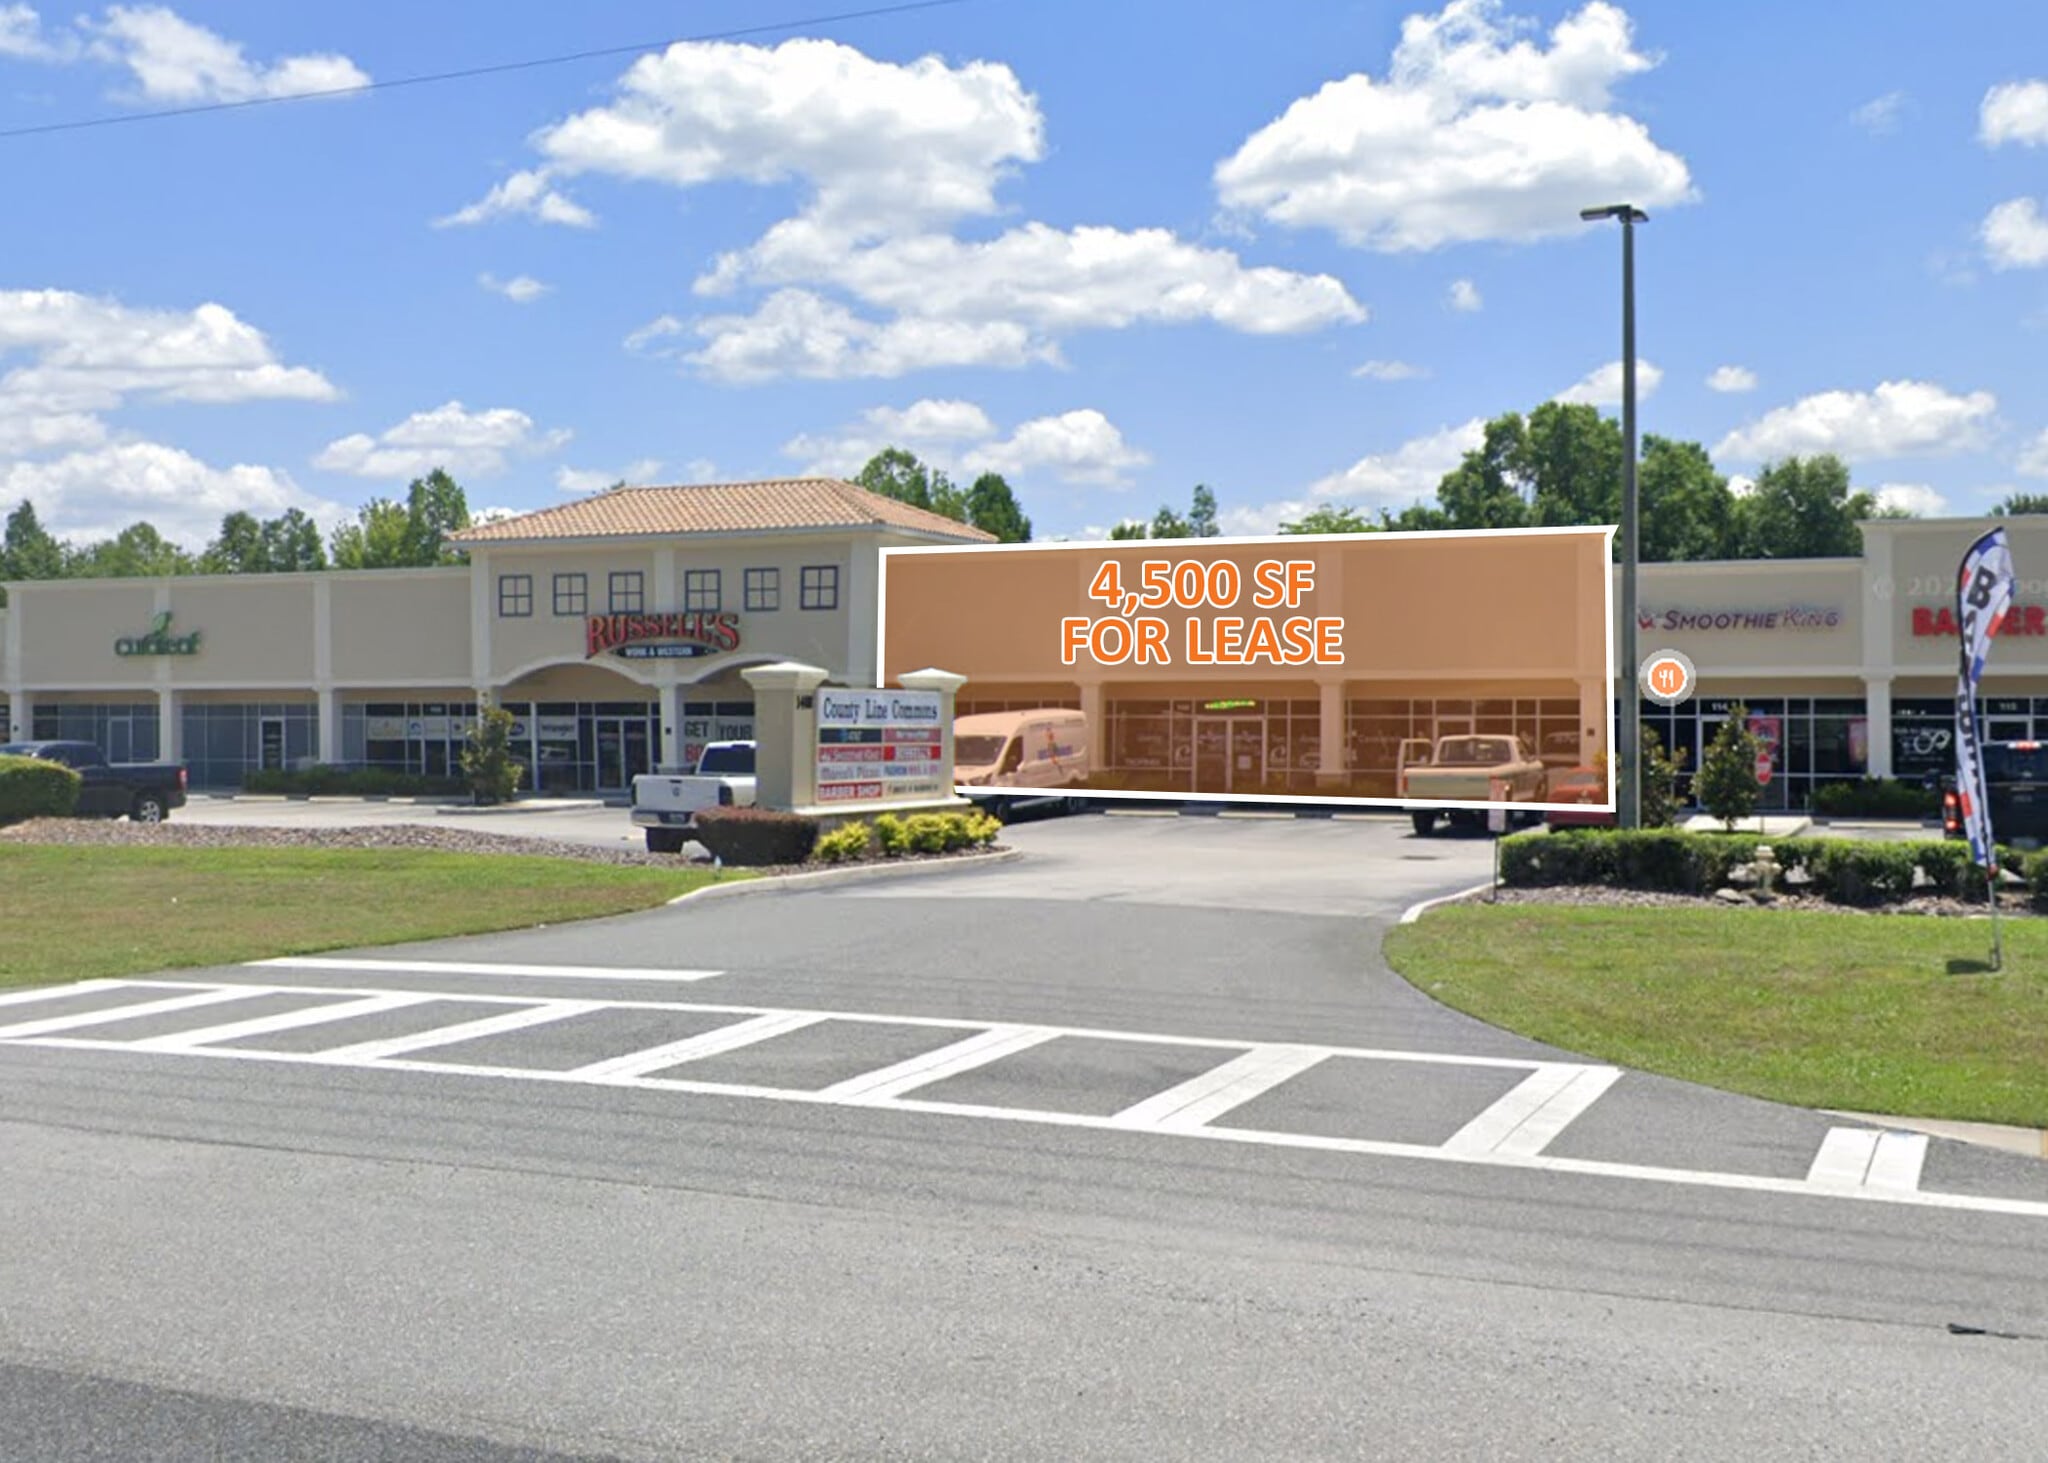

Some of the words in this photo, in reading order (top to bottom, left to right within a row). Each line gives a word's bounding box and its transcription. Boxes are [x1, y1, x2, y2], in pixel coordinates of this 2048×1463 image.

[1662, 609, 1778, 630] SMOOTHIE
[1912, 606, 2046, 637] BAER
[585, 612, 740, 660] RUSSELL'S
[823, 696, 860, 724] County
[865, 698, 888, 719] Line
[891, 699, 938, 719] Commons
[684, 721, 709, 737] GET
